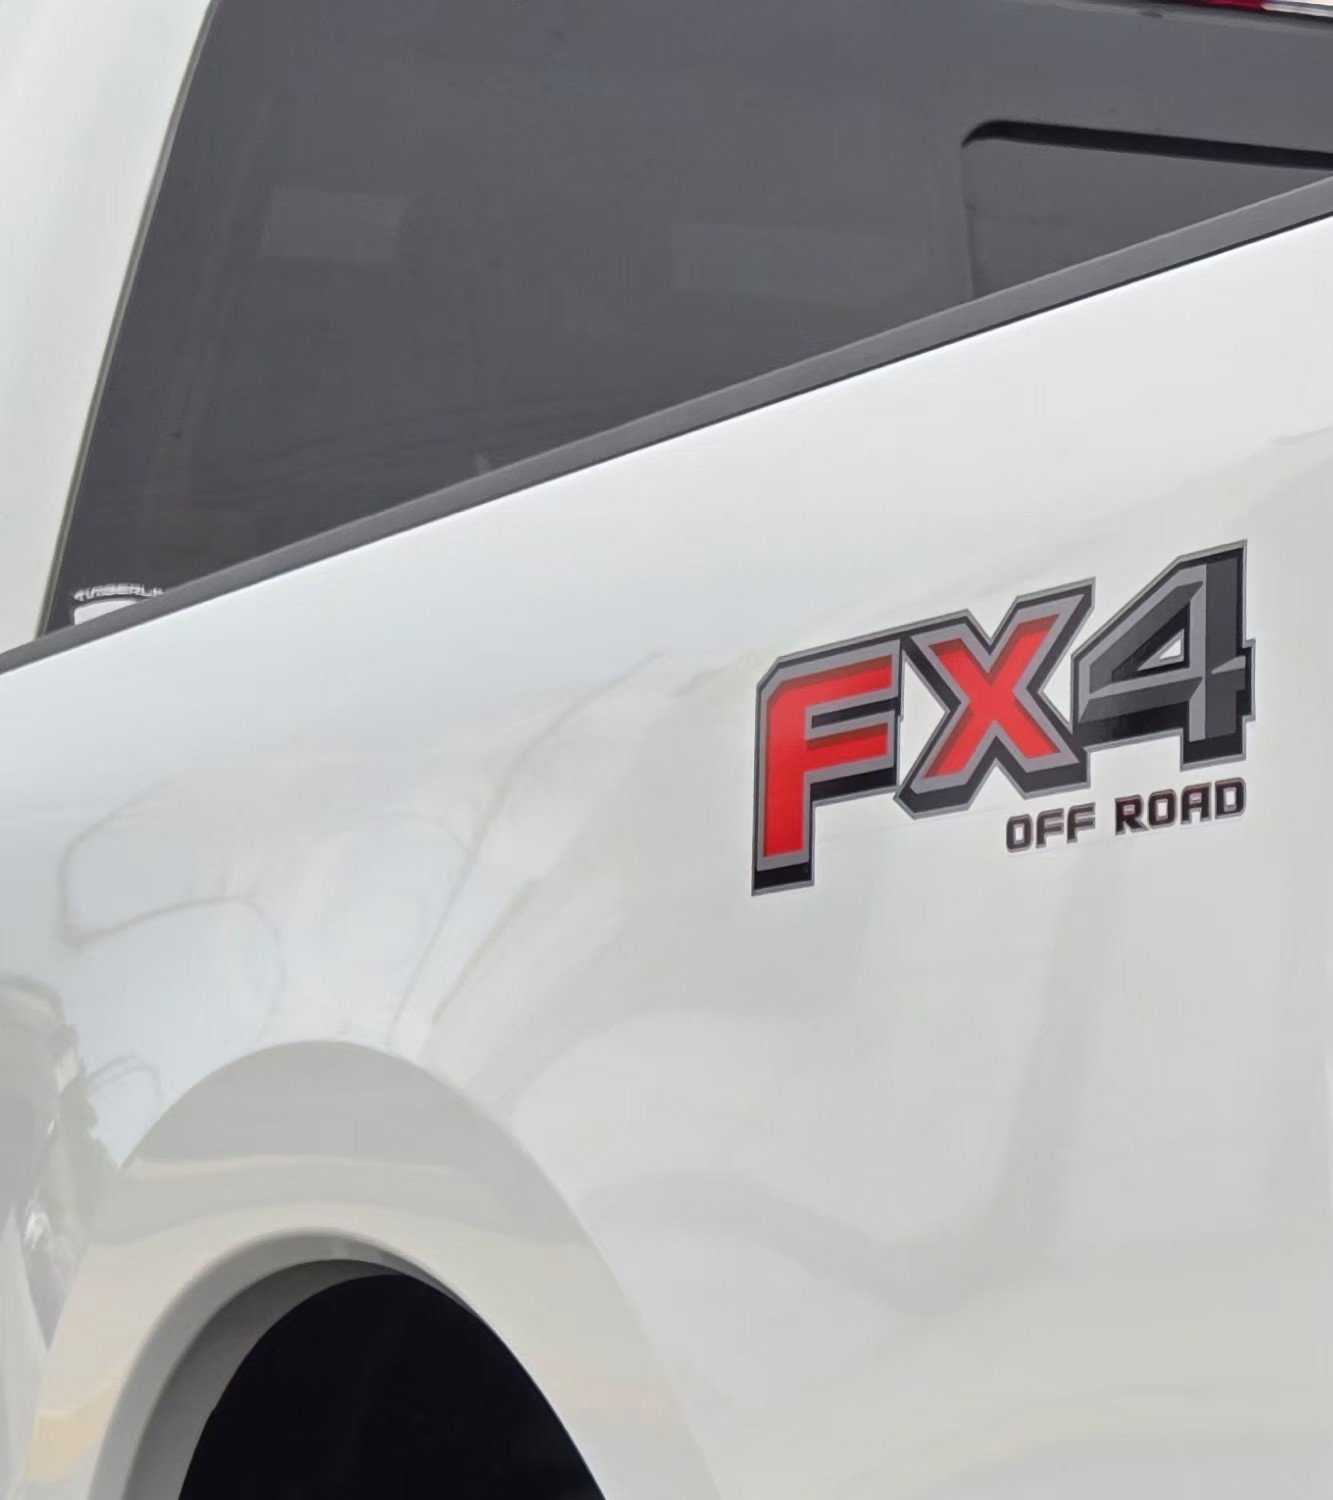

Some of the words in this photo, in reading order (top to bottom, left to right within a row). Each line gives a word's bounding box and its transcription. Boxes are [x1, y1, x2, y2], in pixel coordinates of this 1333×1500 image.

[751, 539, 1256, 896] FX4
[1005, 802, 1096, 854] OFF
[1115, 776, 1247, 836] ROAD
